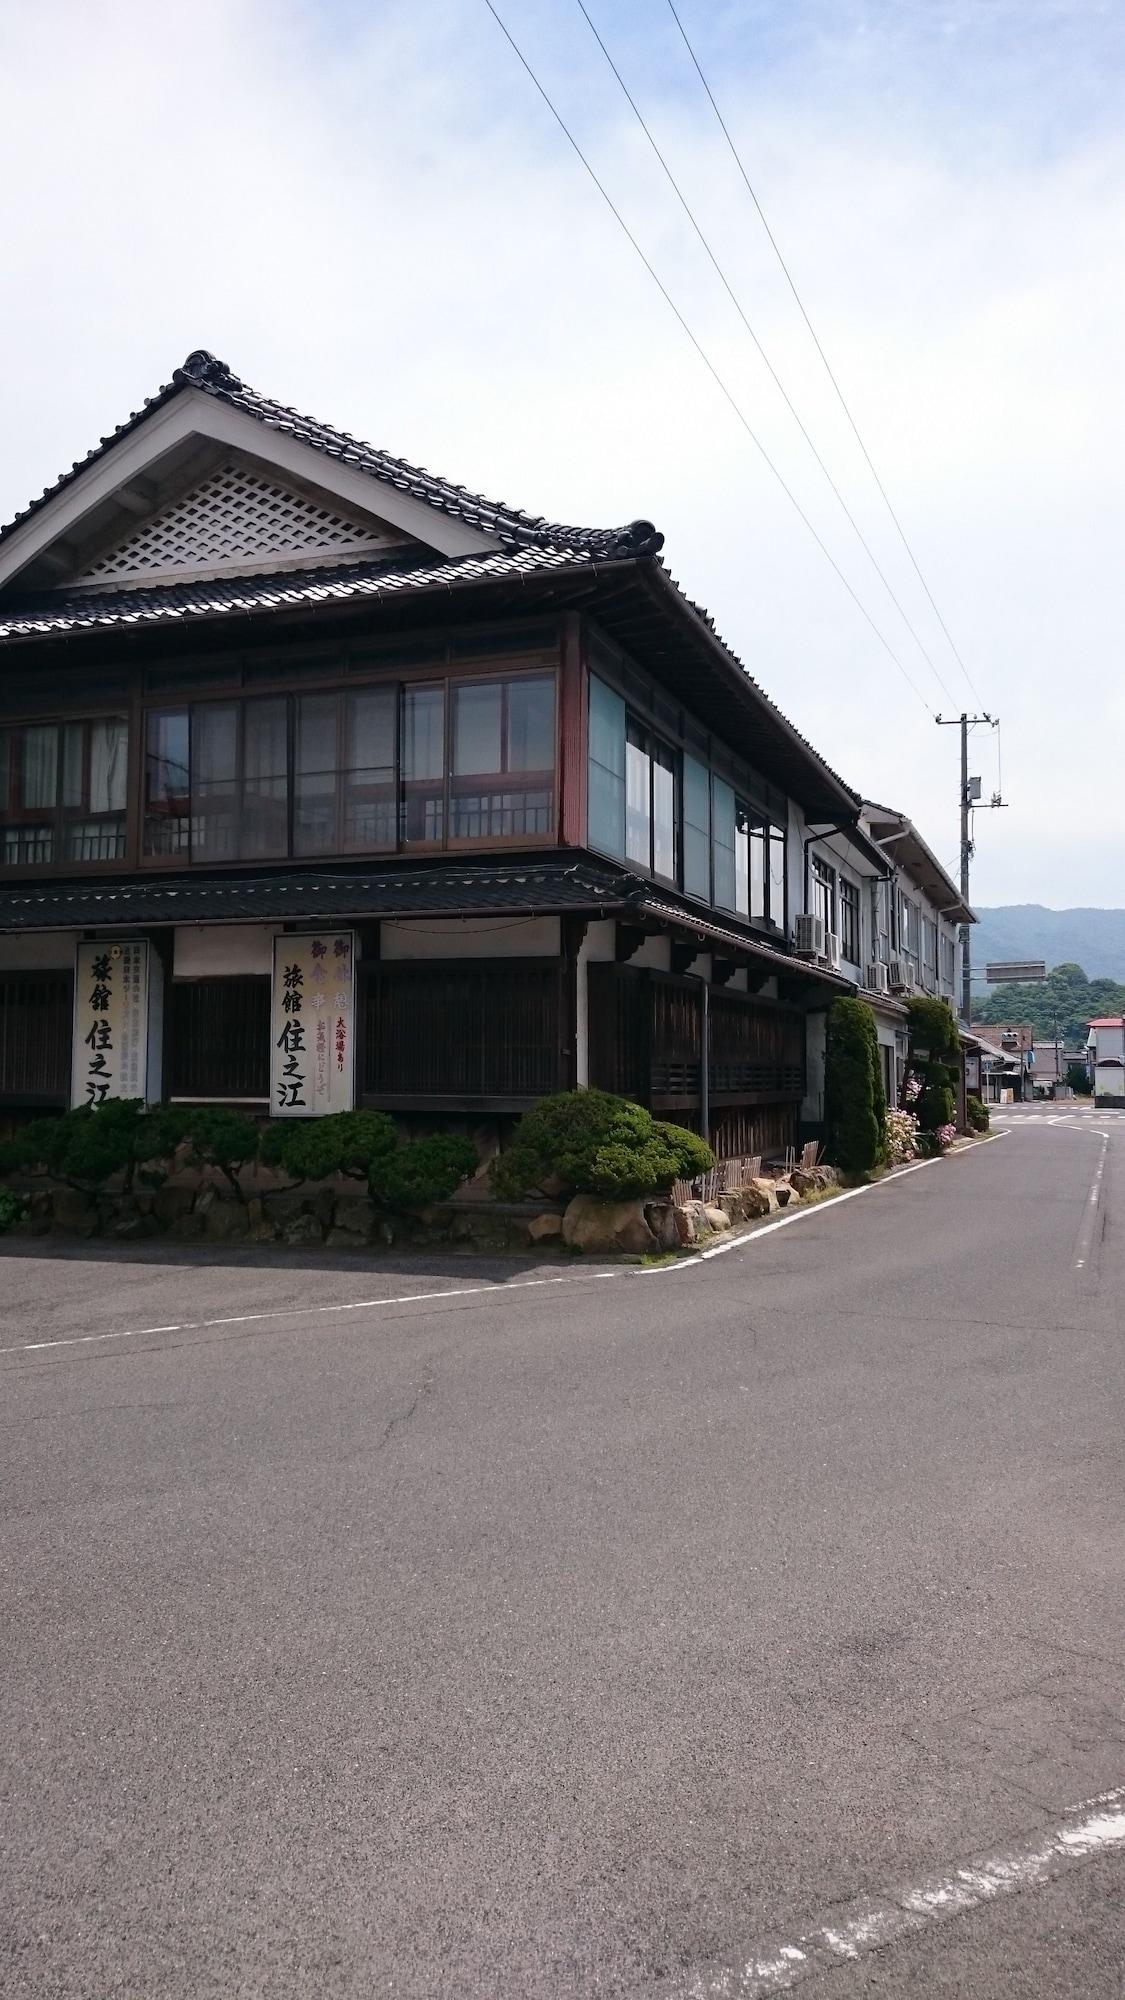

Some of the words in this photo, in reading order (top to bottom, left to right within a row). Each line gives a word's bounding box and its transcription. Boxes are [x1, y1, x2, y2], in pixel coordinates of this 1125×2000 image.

[335, 1016, 347, 1072] 大浴場あり
